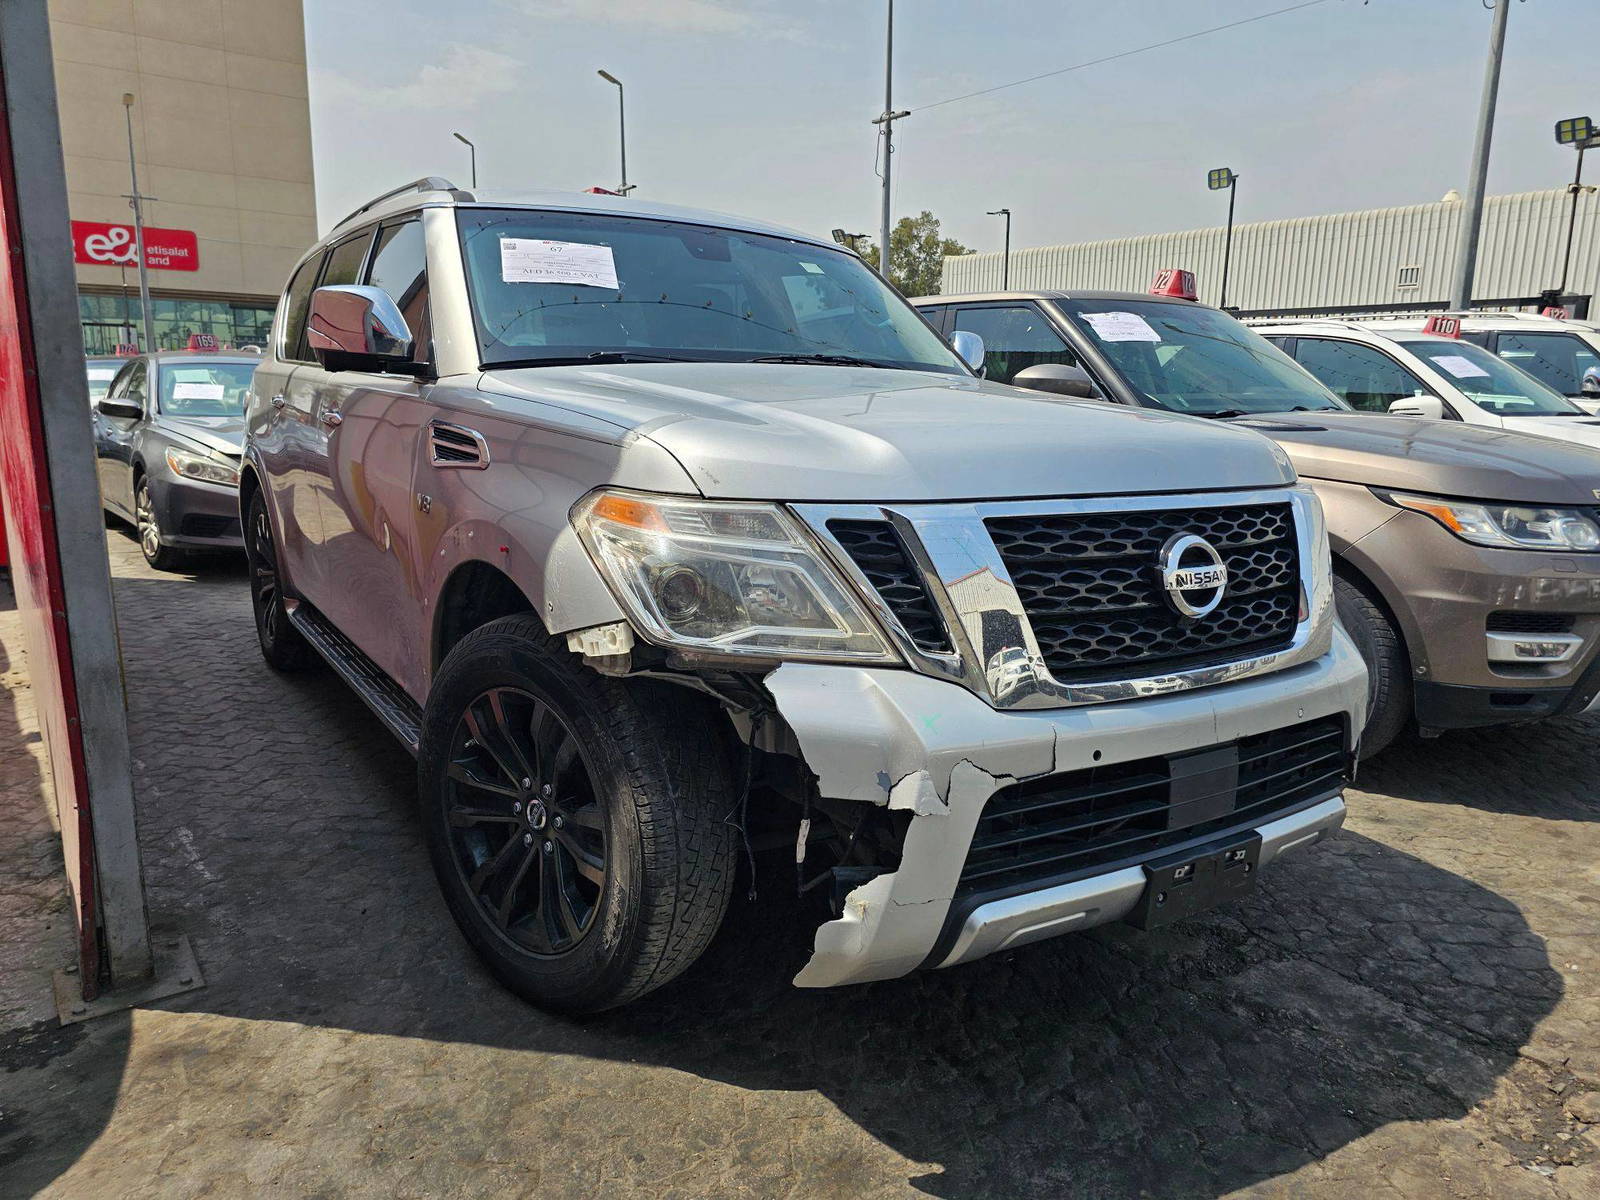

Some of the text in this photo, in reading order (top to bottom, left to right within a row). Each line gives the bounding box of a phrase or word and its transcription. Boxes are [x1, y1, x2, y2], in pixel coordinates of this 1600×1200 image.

[147, 246, 189, 257] etisalat
[148, 256, 170, 265] and
[1154, 271, 1171, 289] 72
[1435, 319, 1455, 334] 110
[197, 335, 214, 347] 169
[1175, 570, 1226, 588] NISSAN
